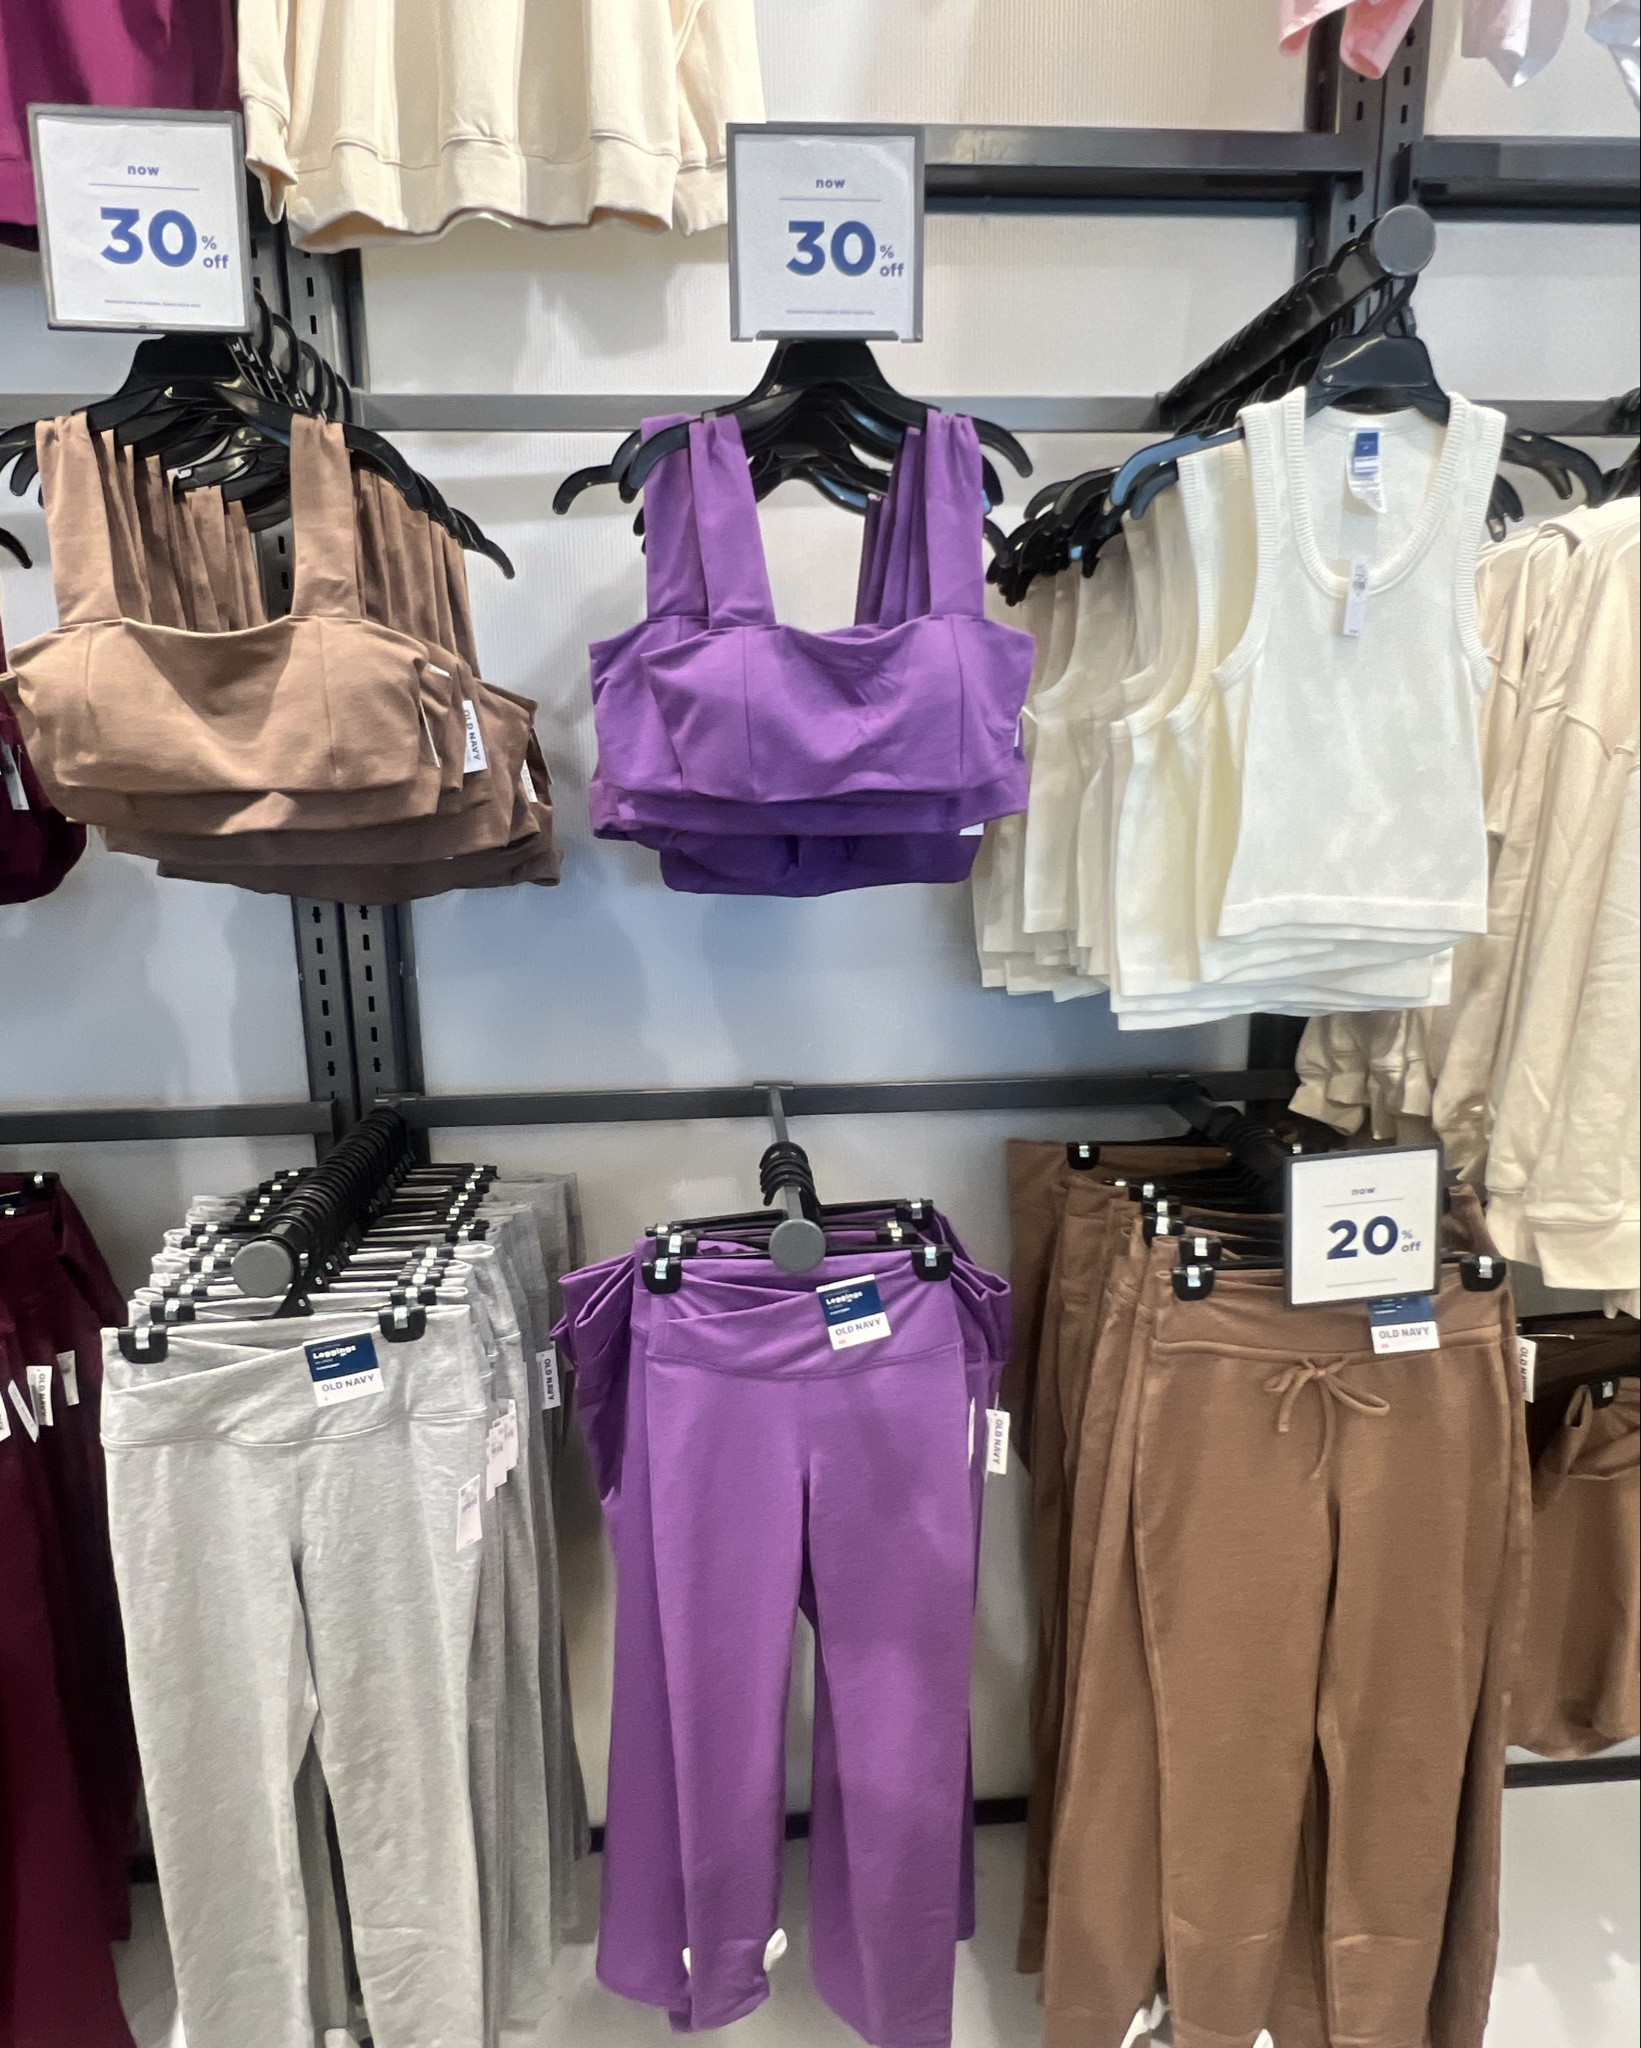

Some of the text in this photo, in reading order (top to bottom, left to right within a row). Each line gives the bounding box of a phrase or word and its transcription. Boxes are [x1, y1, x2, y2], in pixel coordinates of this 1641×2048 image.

[127, 165, 160, 176] now
[815, 178, 846, 189] now
[202, 254, 230, 269] off
[879, 262, 905, 277] off
[469, 732, 480, 760] NAVY
[1350, 1187, 1376, 1196] now
[1401, 1241, 1422, 1253] off
[835, 1317, 881, 1336] OLD NAVY
[1379, 1326, 1430, 1339] OLD NAVY
[1519, 1346, 1529, 1366] OLD
[38, 1373, 46, 1391] OLD
[321, 1373, 374, 1392] OLD NAVY
[544, 1358, 555, 1401] OLD NAVY
[992, 1418, 1004, 1465] OLD NAVY
